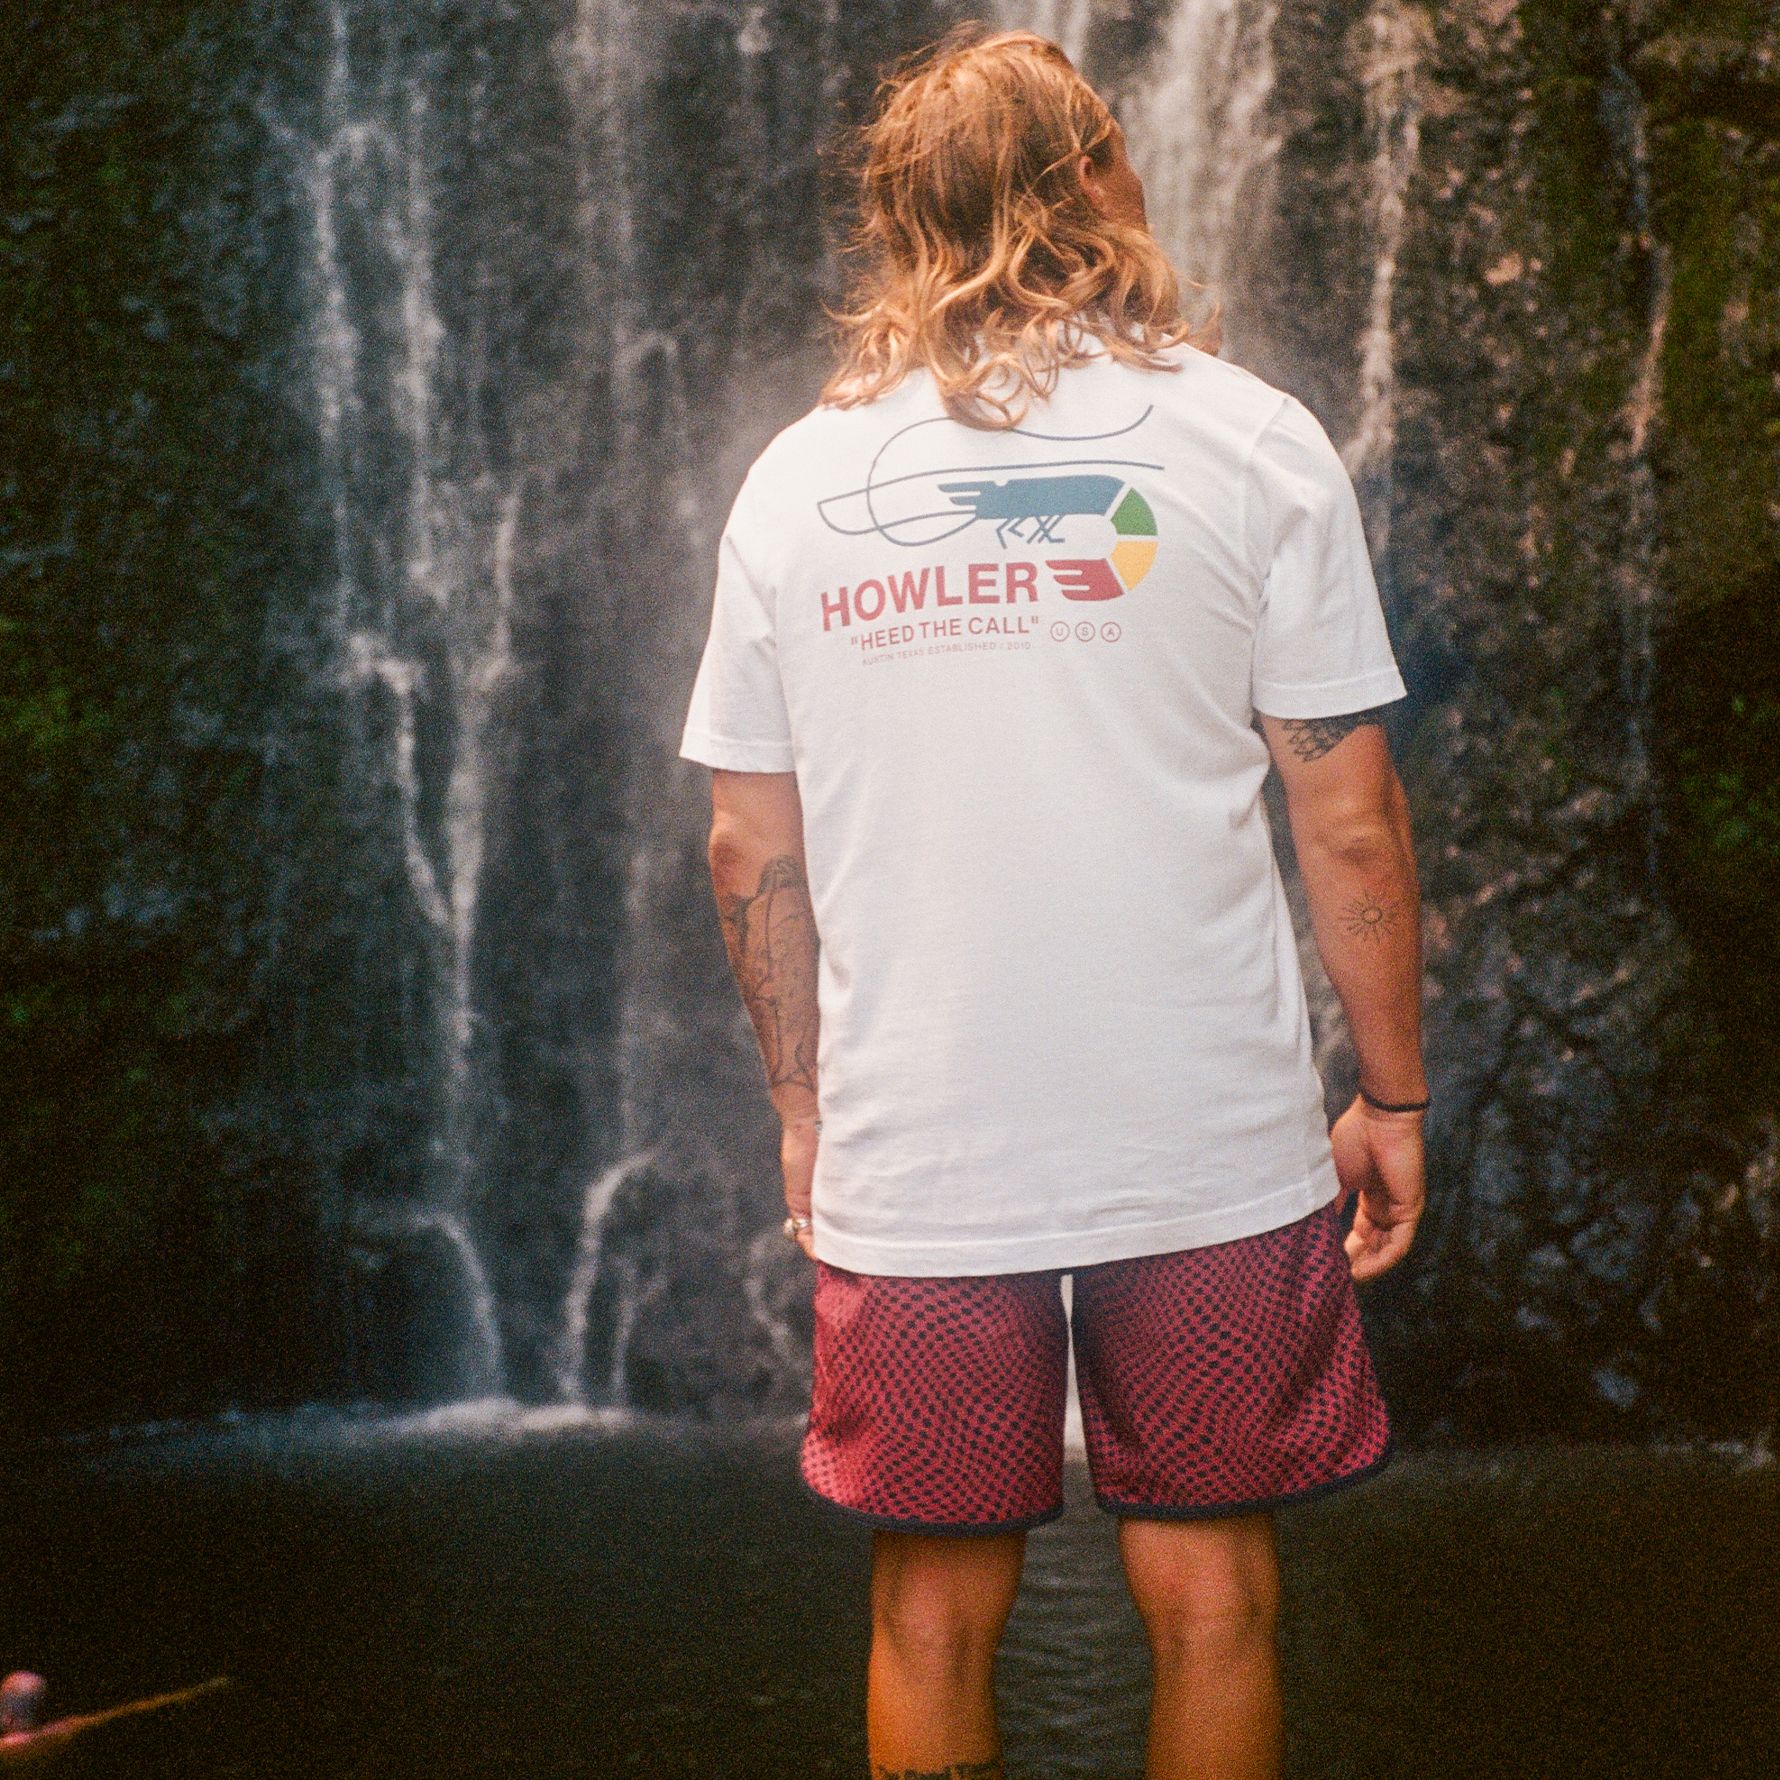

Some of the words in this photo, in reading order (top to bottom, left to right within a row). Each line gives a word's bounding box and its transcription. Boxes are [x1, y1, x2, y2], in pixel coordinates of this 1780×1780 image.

[820, 561, 1039, 632] HOWLER
[851, 624, 915, 651] "HEED
[919, 618, 962, 639] THE
[968, 616, 1039, 635] CALL"
[897, 648, 924, 659] TEXAS
[928, 641, 996, 655] ESTABLISHED
